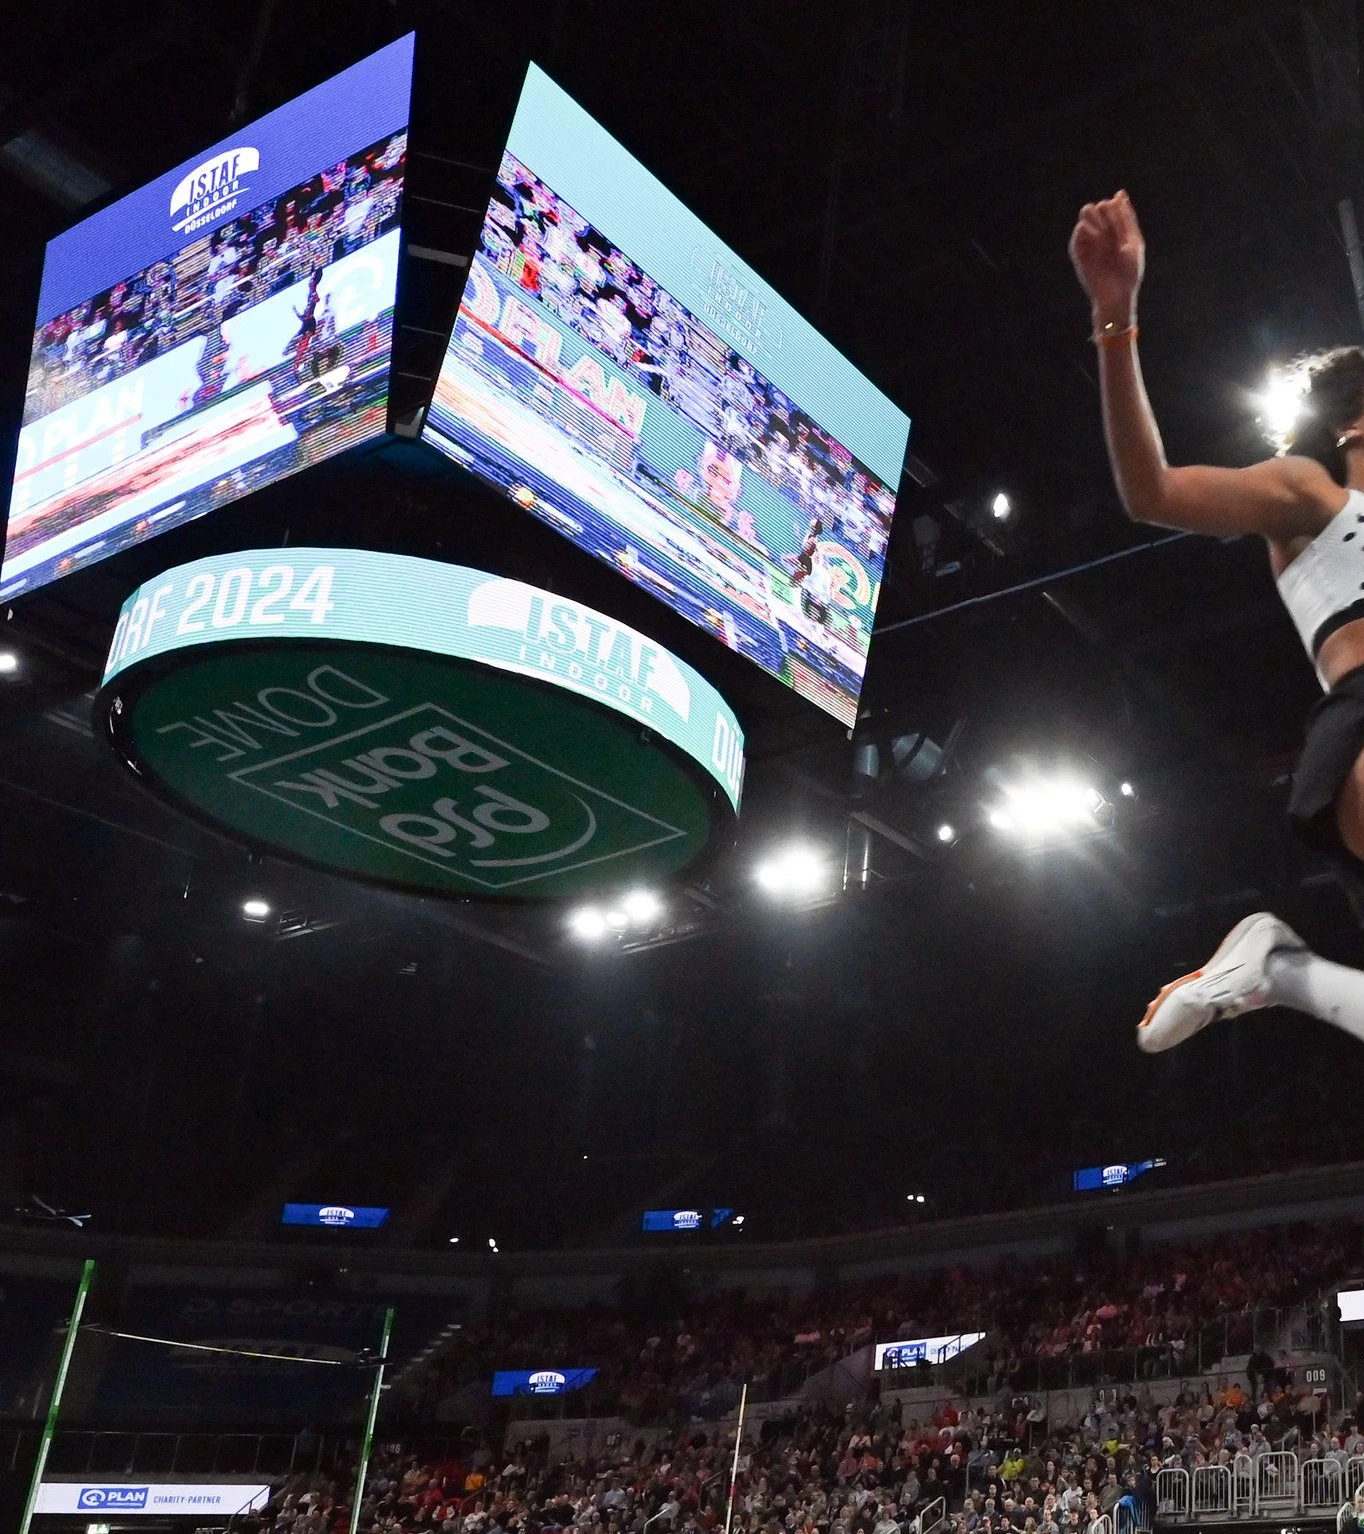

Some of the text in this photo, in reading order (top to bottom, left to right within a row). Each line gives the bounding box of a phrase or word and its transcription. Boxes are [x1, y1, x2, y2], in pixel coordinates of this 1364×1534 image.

[186, 179, 239, 218] INDOOR
[189, 153, 241, 204] ISTAF
[176, 565, 335, 635] 2024
[525, 595, 659, 689] ISTAF
[519, 645, 655, 713] INDOOR
[155, 664, 391, 762] DOME
[274, 726, 512, 809] Bank
[902, 1346, 925, 1357] PLAN
[107, 1491, 146, 1502] PLAN
[153, 1495, 222, 1505] CHARITY-PARTNER
